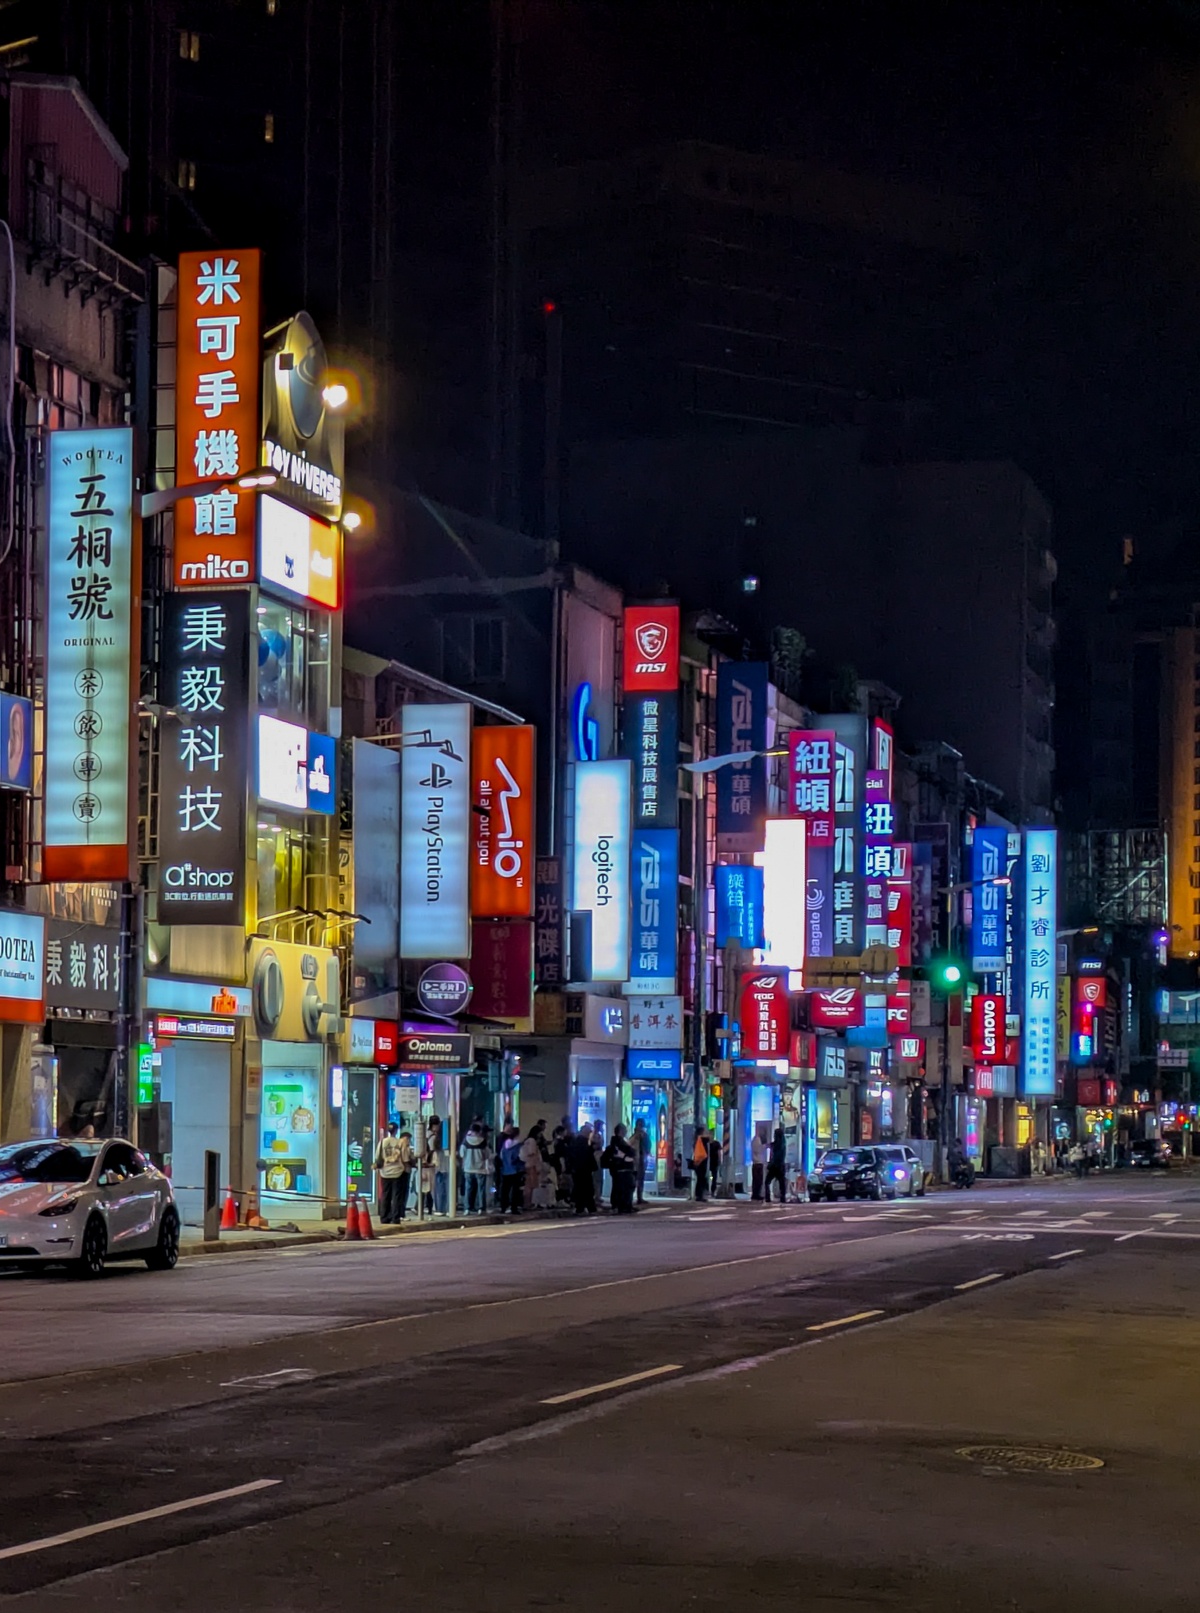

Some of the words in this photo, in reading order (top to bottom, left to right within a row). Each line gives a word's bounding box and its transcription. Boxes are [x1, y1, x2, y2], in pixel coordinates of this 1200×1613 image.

[195, 258, 240, 535] 米可手機館
[61, 449, 124, 466] WOOTEA
[66, 475, 114, 621] 五桐號
[182, 555, 249, 580] miko
[64, 637, 115, 647] ORIGINAL
[635, 663, 667, 673] msi
[179, 605, 227, 832] 秉毅科技
[78, 672, 98, 818] 茶飲專賣
[642, 701, 658, 816] 微星科技展售店
[480, 780, 491, 795] all
[731, 774, 752, 815] 華碩
[795, 741, 831, 813] 紐頓
[866, 778, 883, 789] cial
[422, 797, 444, 902] PlayStation
[477, 841, 490, 865] you
[866, 803, 893, 878] 紐頓
[592, 835, 613, 906] logitech
[641, 841, 659, 927] ASUS
[982, 914, 998, 946] 華碩
[1031, 854, 1050, 999] 劉才睿診所
[640, 931, 659, 970] 華碩
[631, 1014, 678, 1029] 普洱茶
[887, 1009, 908, 1021] FC
[982, 1000, 996, 1055] Lenovo
[409, 1040, 452, 1053] Optoma
[637, 1061, 672, 1069] ASUS
